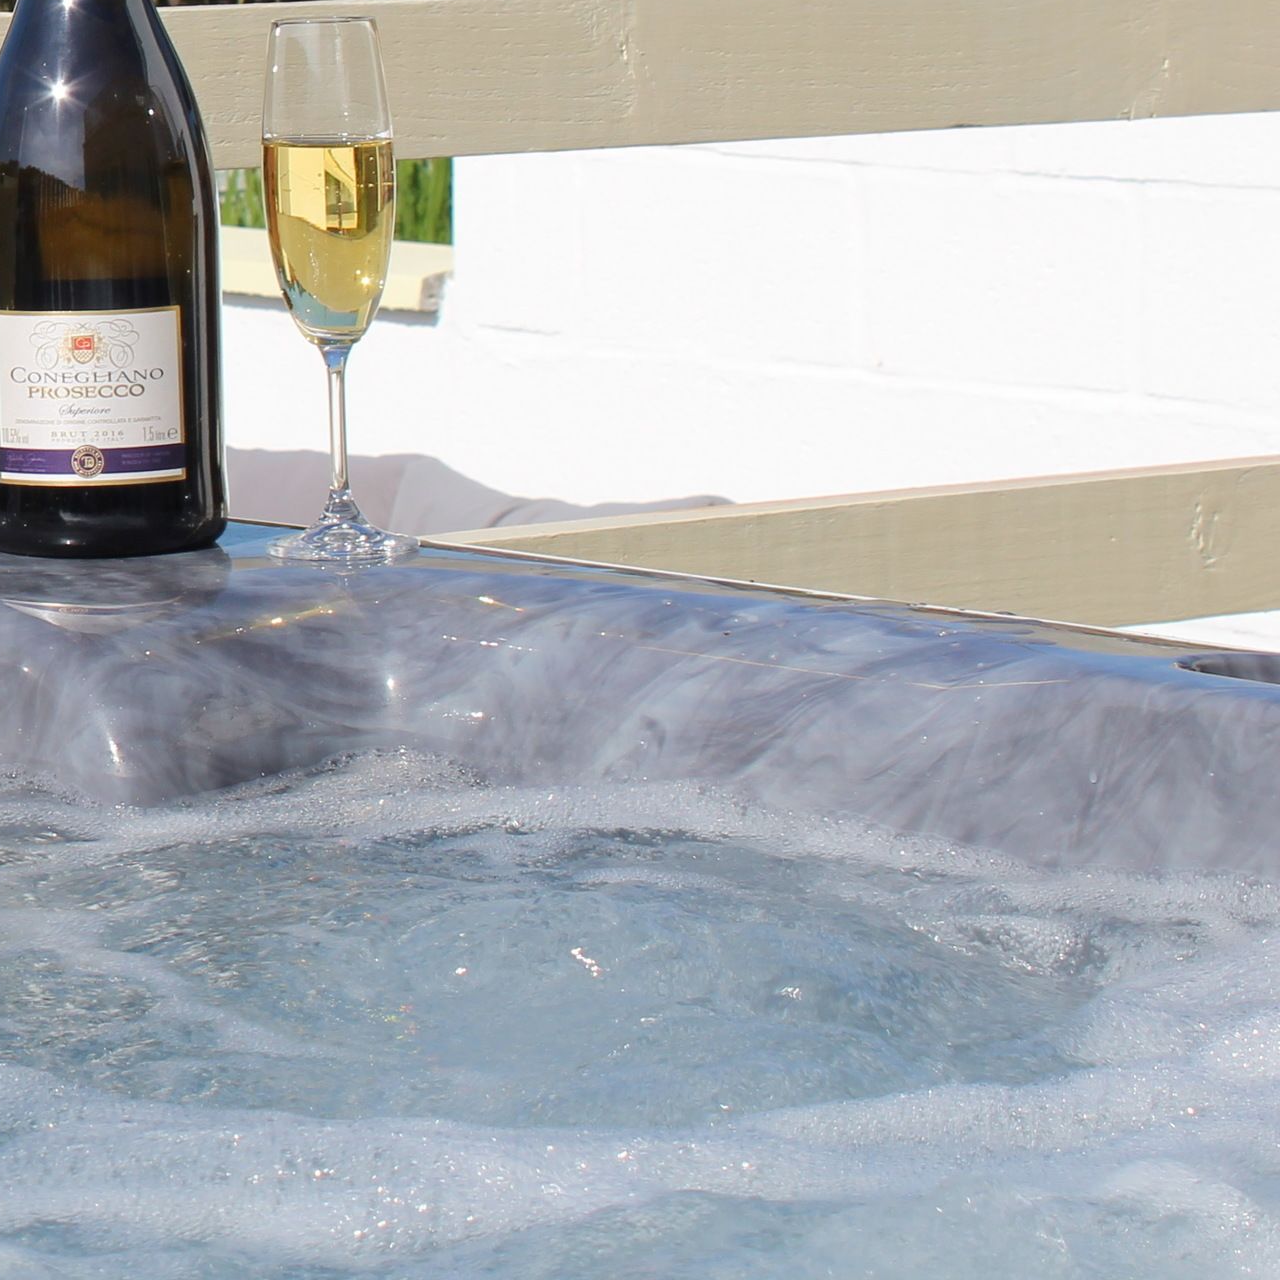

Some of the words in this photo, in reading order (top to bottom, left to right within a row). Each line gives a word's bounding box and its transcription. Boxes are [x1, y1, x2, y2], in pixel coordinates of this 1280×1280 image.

[10, 366, 165, 384] CONEGLIANO
[28, 383, 145, 399] PROSECCO
[58, 403, 111, 418] Superiore
[50, 430, 87, 438] BRUT
[94, 429, 125, 437] 2016
